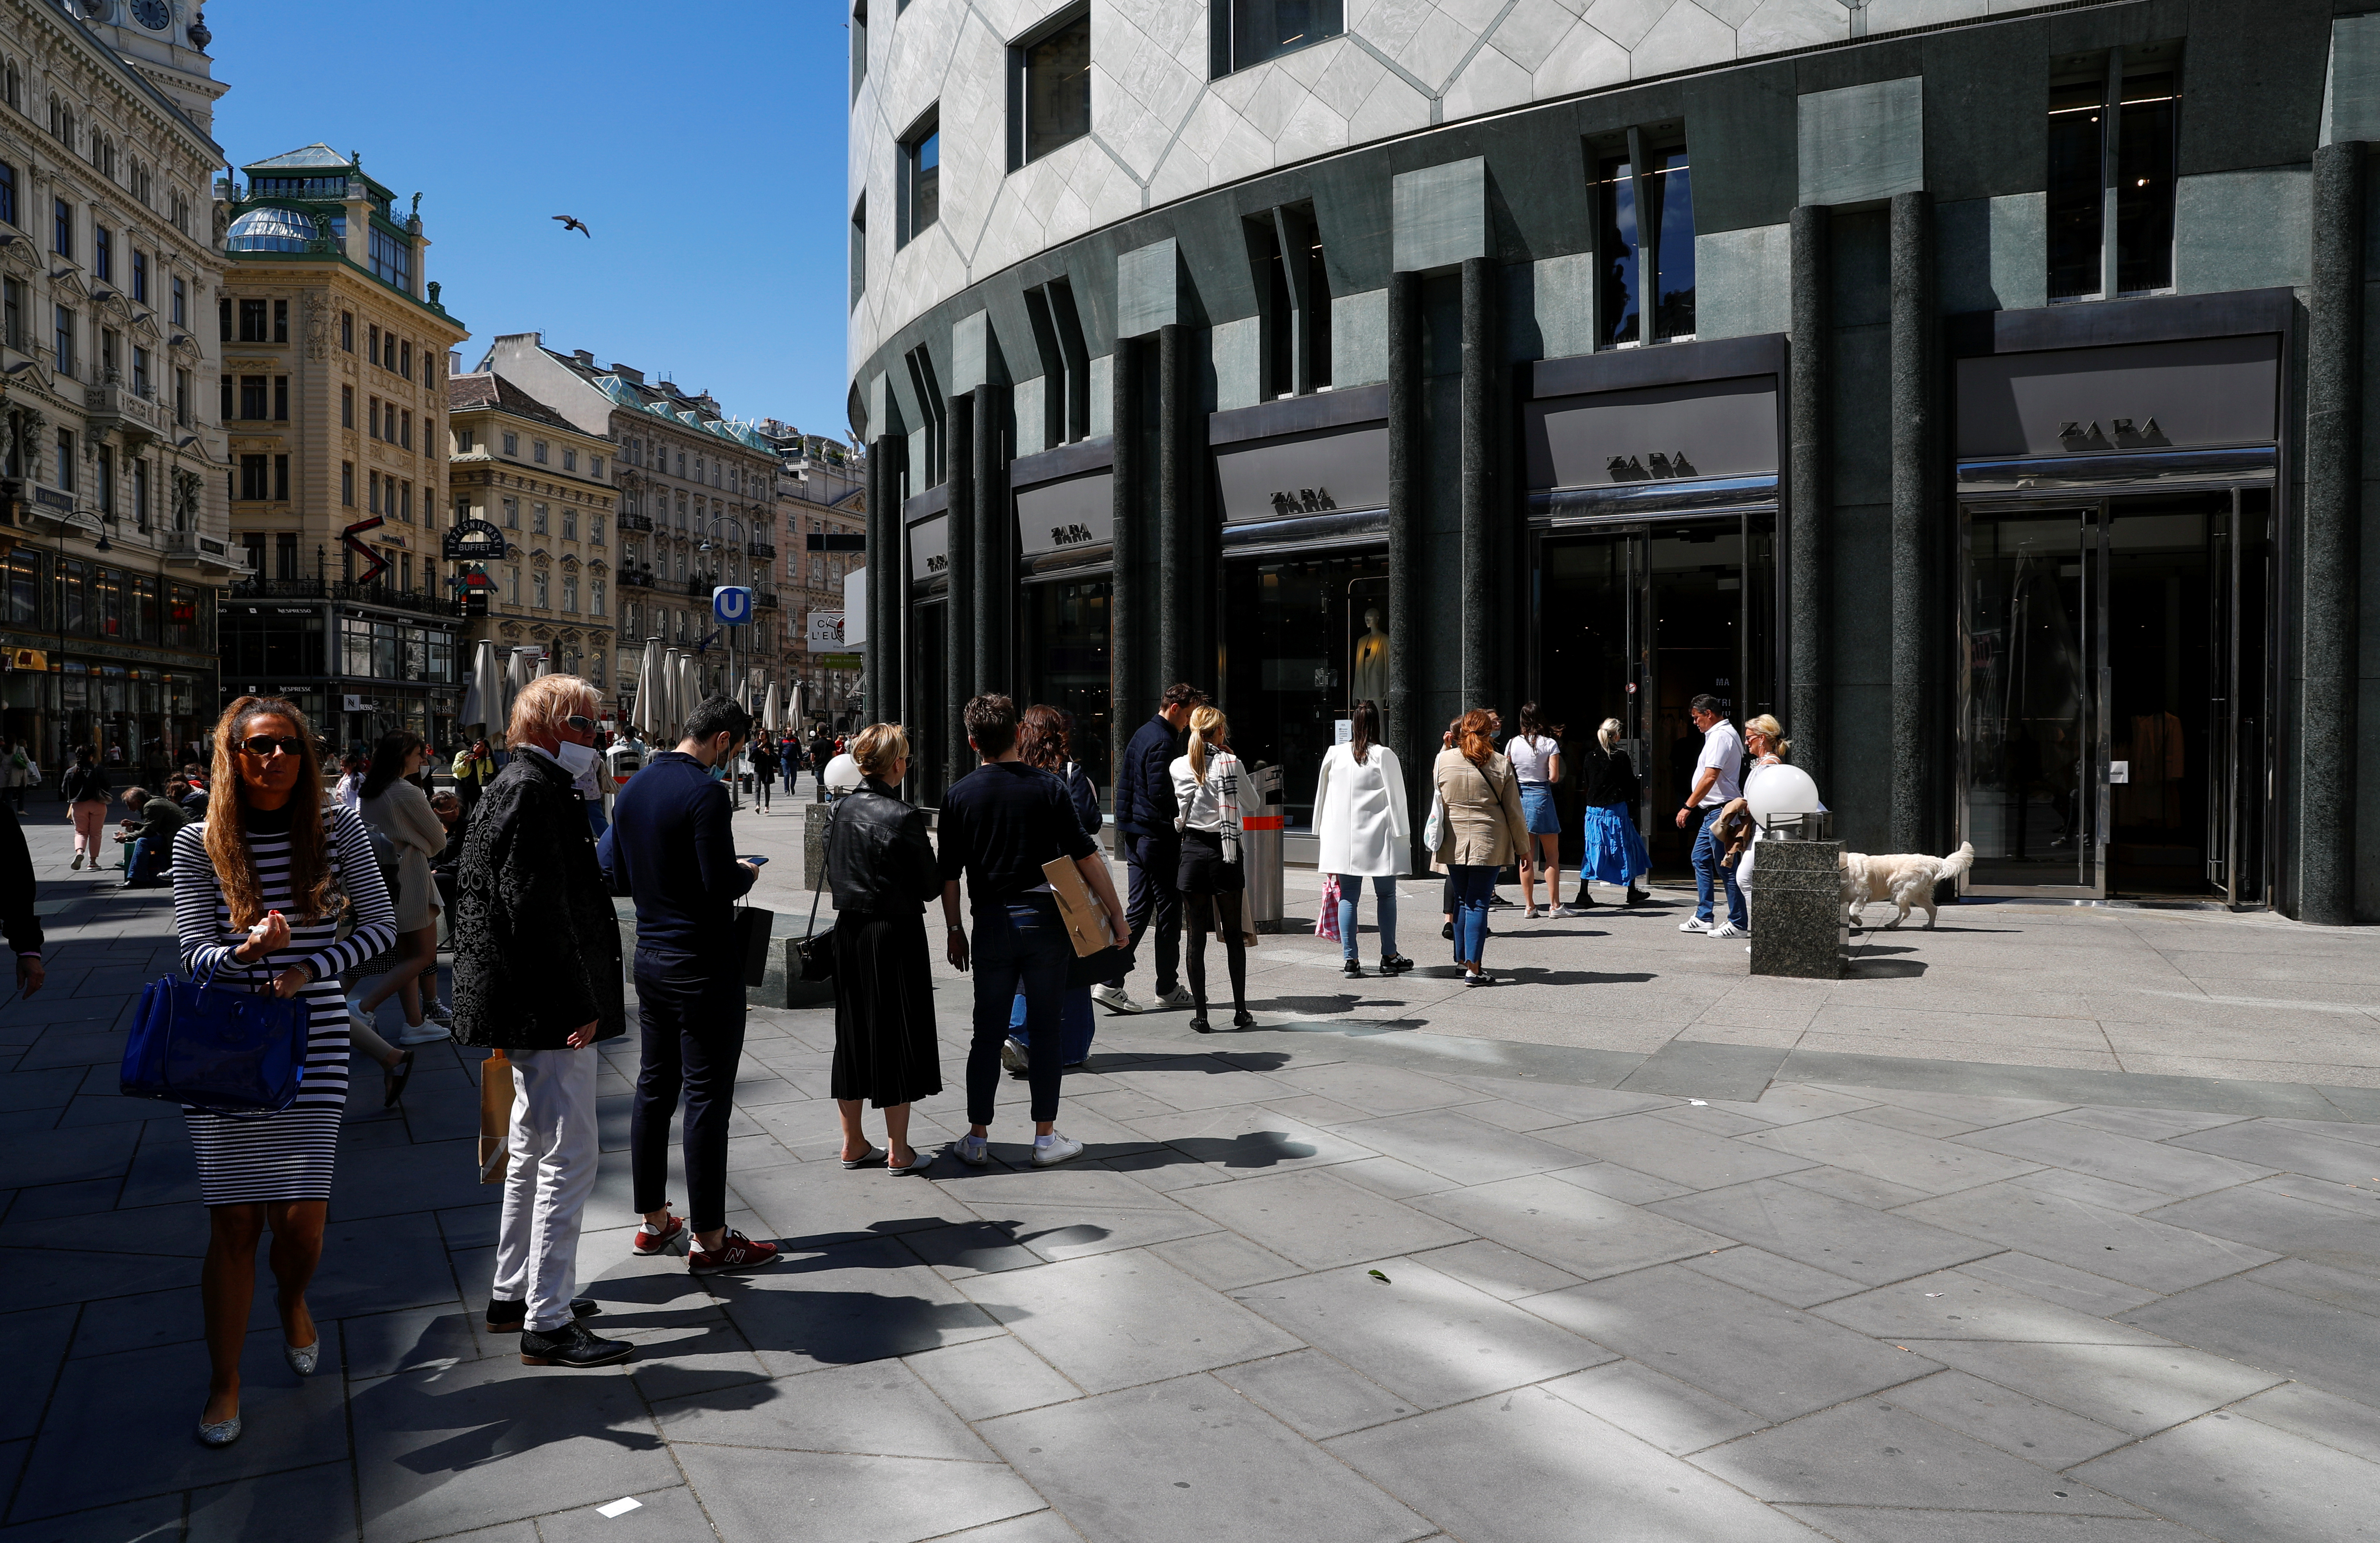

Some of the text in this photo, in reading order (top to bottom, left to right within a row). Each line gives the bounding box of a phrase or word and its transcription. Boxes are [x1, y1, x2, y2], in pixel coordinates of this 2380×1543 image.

[2058, 416, 2164, 438] ZARA
[1607, 450, 1691, 470] ZARA
[45, 493, 60, 504] BRAUN
[1270, 486, 1331, 505] ZARA
[448, 521, 502, 550] TRZESNIEWSKI
[1051, 522, 1090, 538] ZARA
[721, 594, 744, 619] U
[1716, 678, 1730, 686] MA
[725, 1247, 746, 1264] N
